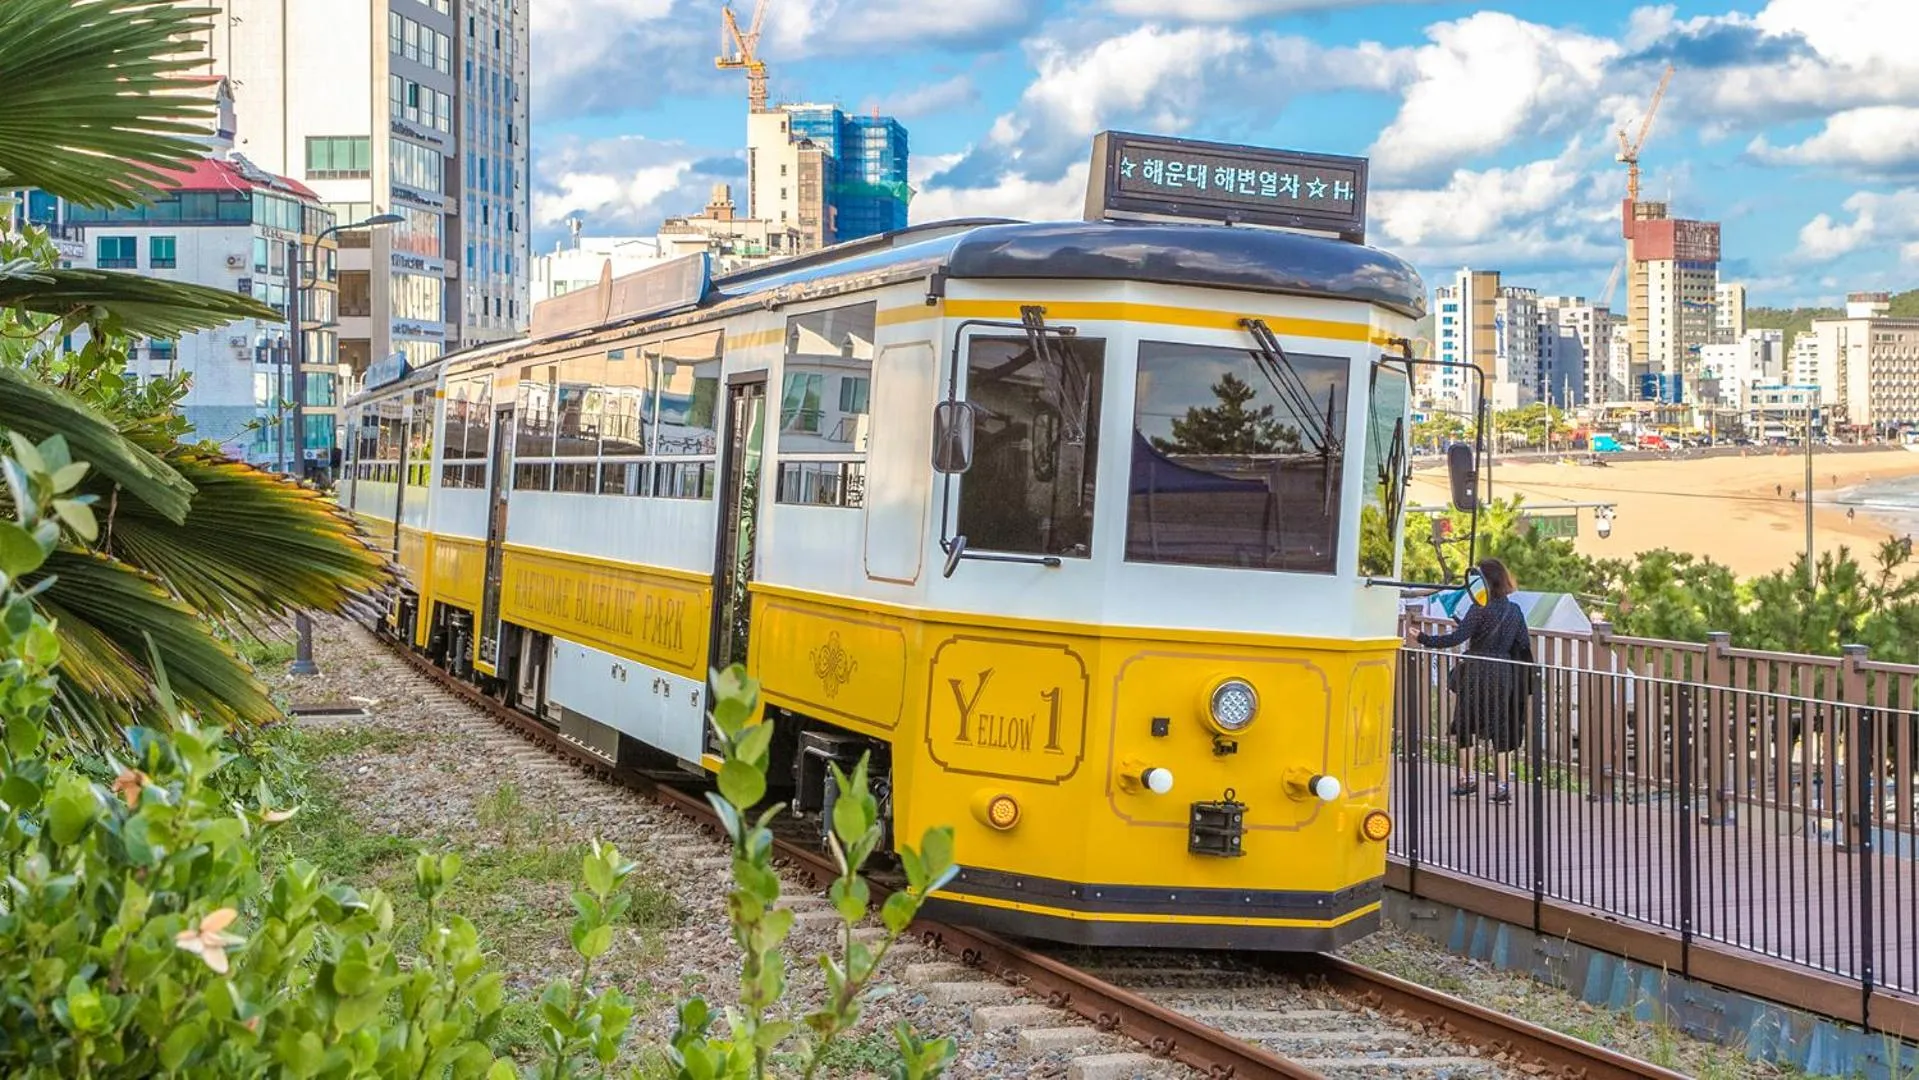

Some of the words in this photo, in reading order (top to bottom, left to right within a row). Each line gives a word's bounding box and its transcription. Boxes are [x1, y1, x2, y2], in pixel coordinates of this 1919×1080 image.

[1143, 158, 1208, 189] 해운대
[1214, 166, 1300, 199] 해변열차
[514, 568, 569, 619] HAEUNDAE
[574, 578, 637, 635] BLUELINE
[642, 594, 686, 652] PARK
[1040, 686, 1064, 756] 1
